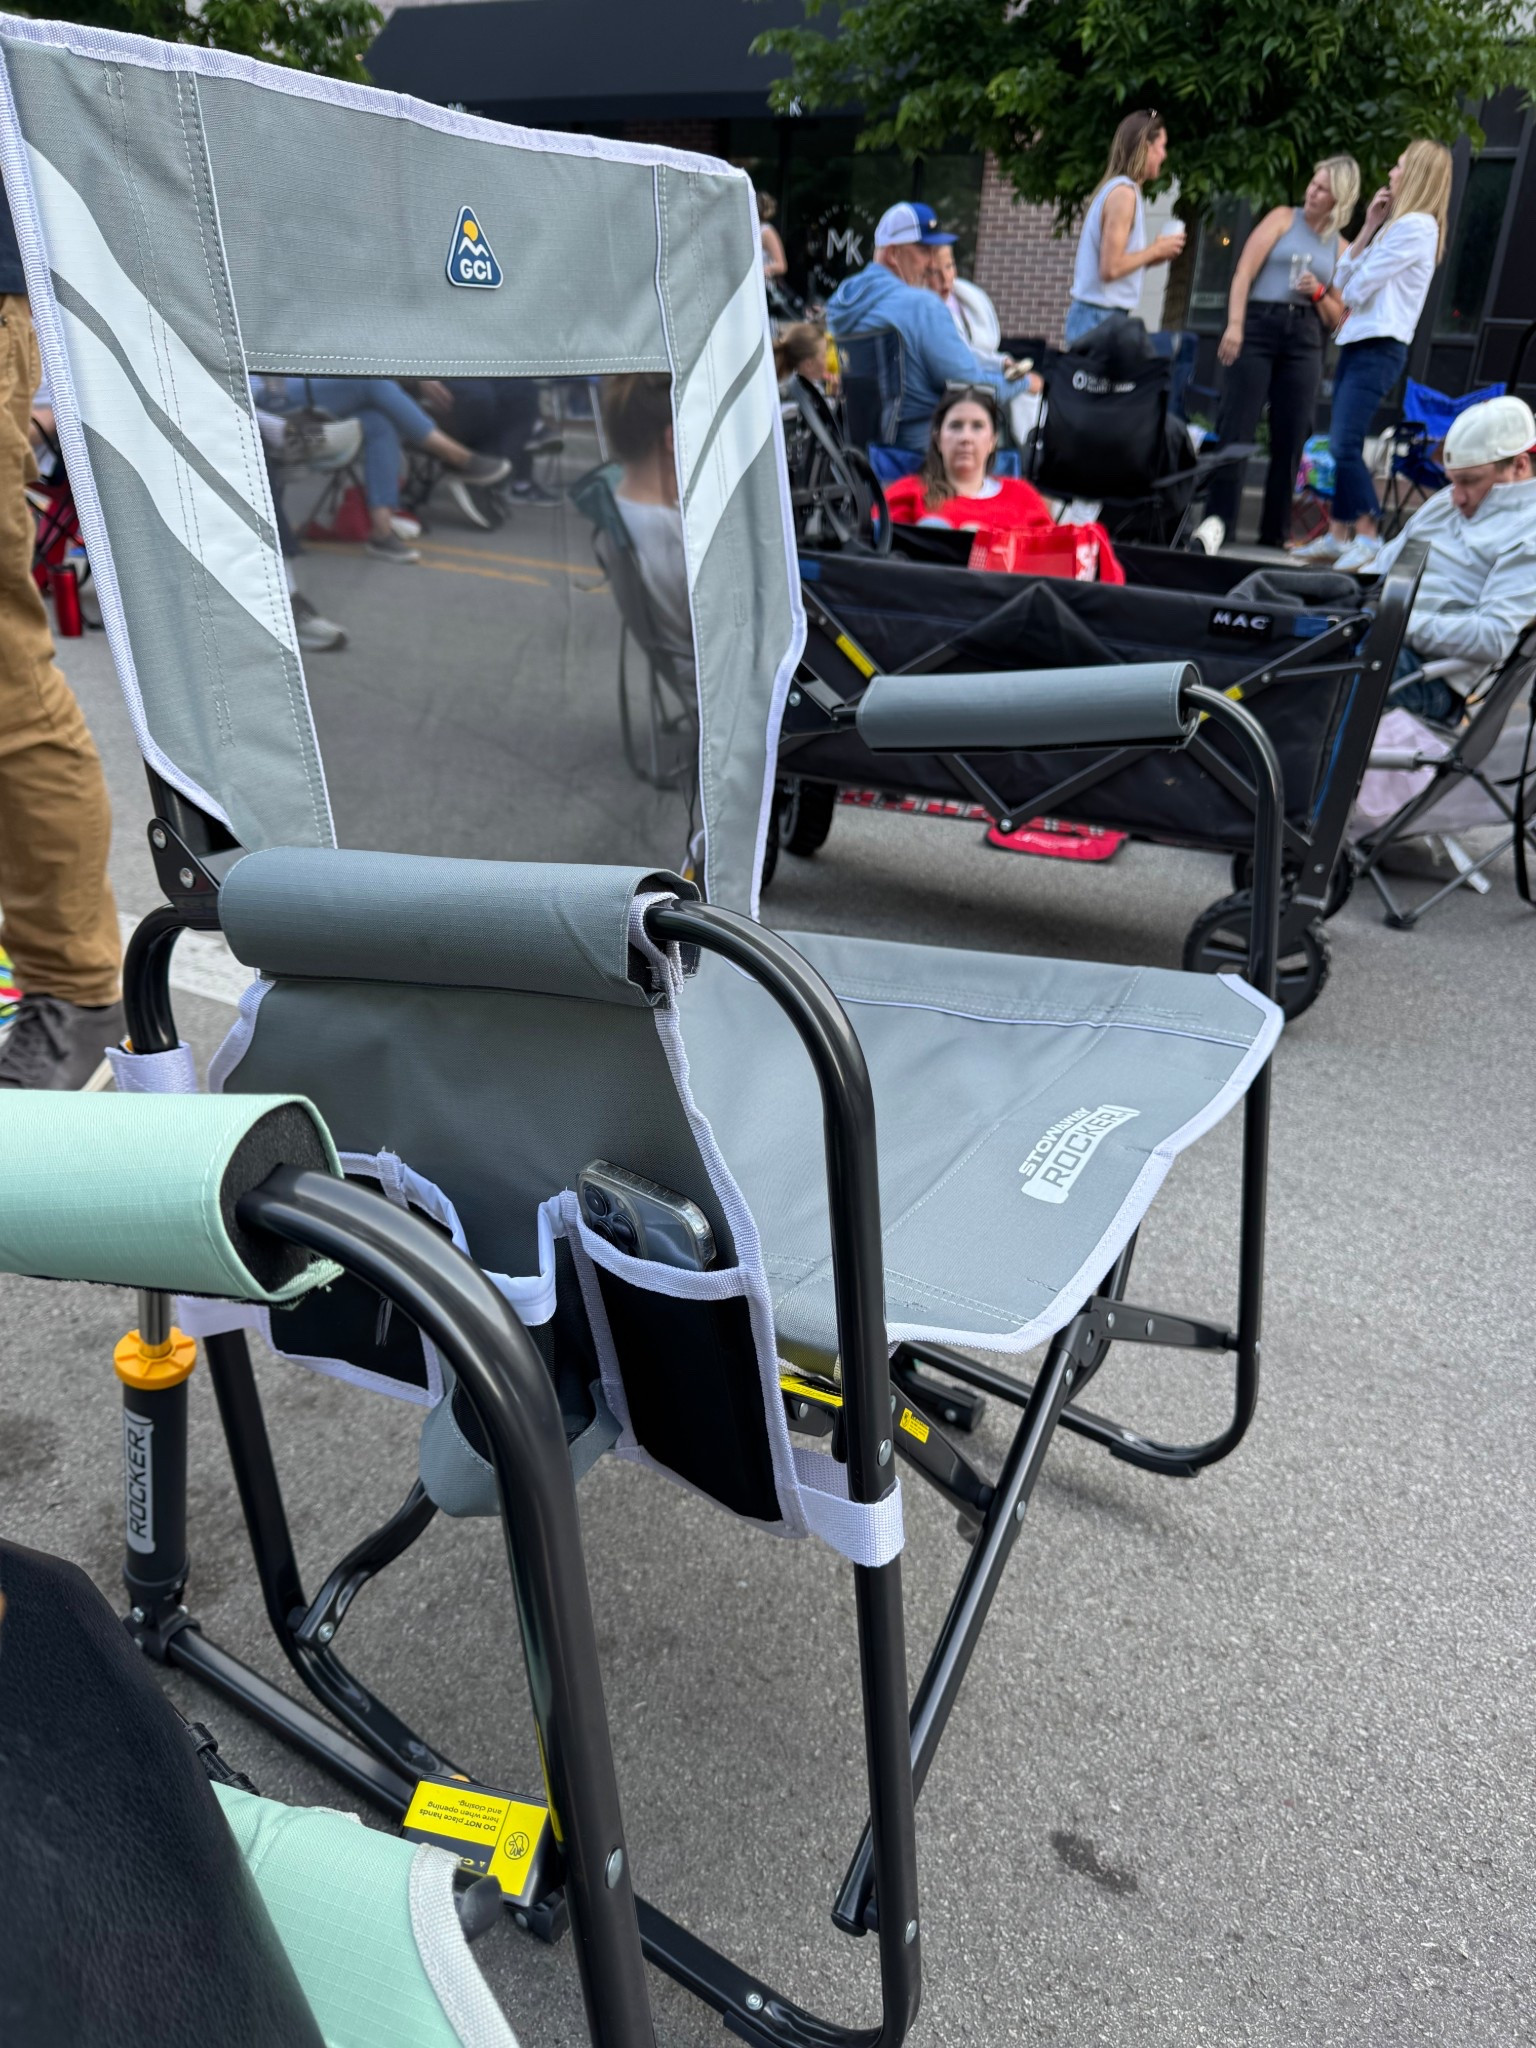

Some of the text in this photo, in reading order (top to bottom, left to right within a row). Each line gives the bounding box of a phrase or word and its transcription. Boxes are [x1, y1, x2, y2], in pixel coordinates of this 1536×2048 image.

[826, 227, 865, 267] MK
[460, 258, 492, 280] GCI
[1213, 610, 1270, 630] MAC
[1018, 1107, 1092, 1177] STOWAWAY
[1040, 1112, 1118, 1188] ROCKER
[127, 1427, 147, 1539] ROCKER
[427, 1801, 499, 1823] here when opening
[458, 1800, 502, 1815] and closing.
[419, 1808, 497, 1832] DO NOT place hands
